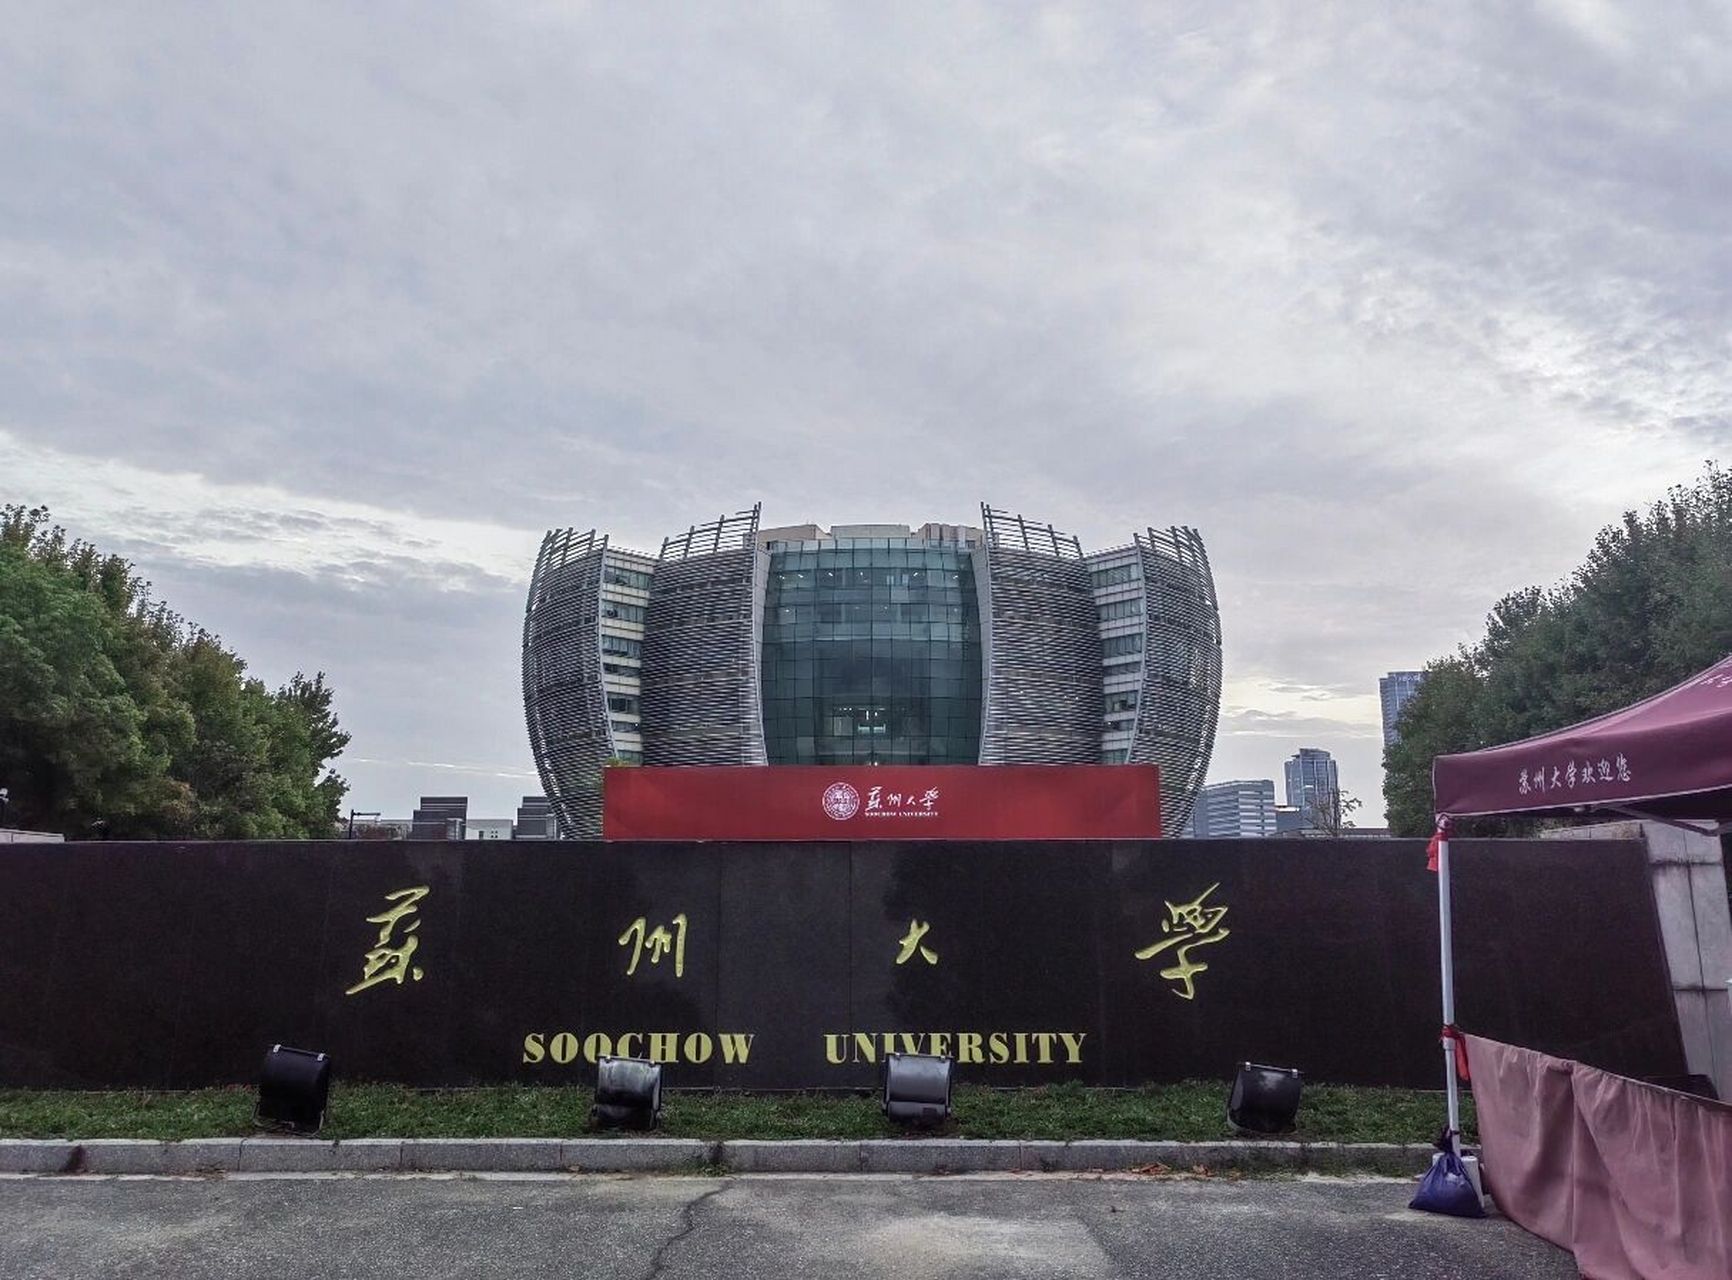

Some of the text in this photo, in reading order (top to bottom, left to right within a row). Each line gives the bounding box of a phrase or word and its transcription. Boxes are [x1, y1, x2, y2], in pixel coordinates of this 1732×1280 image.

[1518, 752, 1632, 796] 苏州大学欢迎您
[522, 1032, 1087, 1064] SOOCHOW UNIVERSITY
